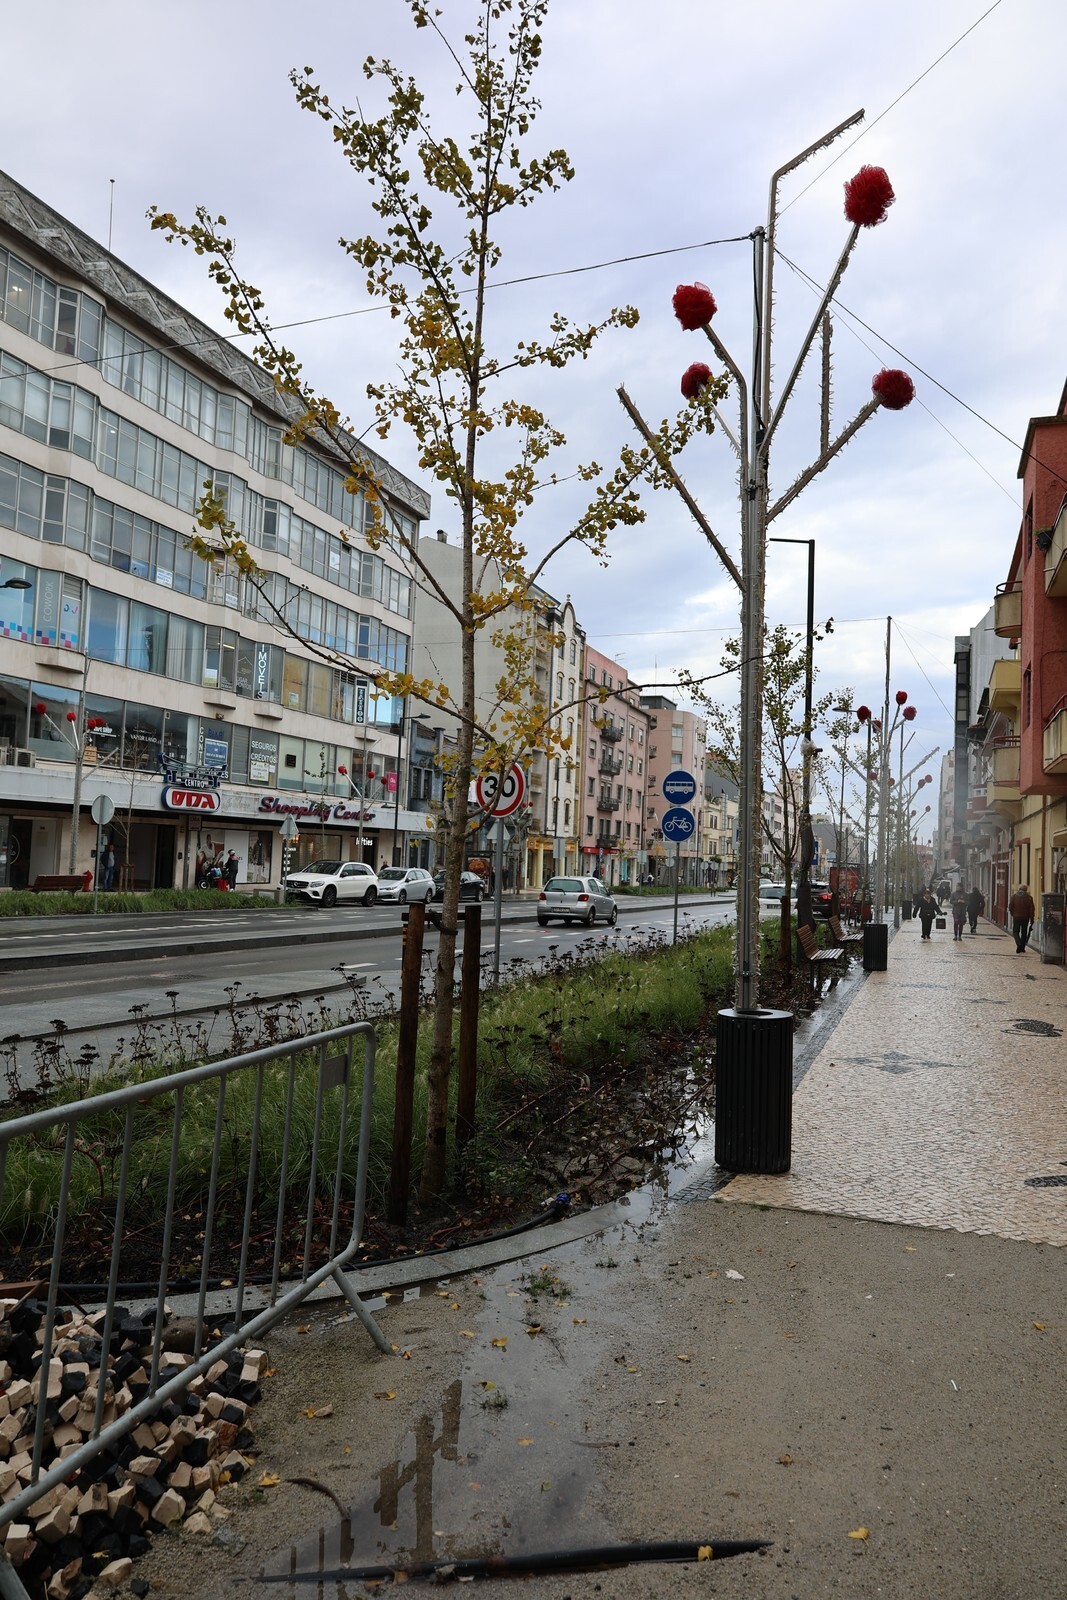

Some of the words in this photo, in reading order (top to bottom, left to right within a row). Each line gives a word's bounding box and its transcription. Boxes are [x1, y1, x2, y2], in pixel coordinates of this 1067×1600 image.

[43, 581, 54, 622] COWORK
[357, 688, 366, 722] TATTOO
[251, 740, 277, 752] SEGUROS
[250, 752, 277, 764] CRÉDITOS
[184, 778, 205, 788] CENTRO
[484, 775, 516, 798] 30
[258, 796, 331, 822] Shopping
[333, 804, 376, 821] Center
